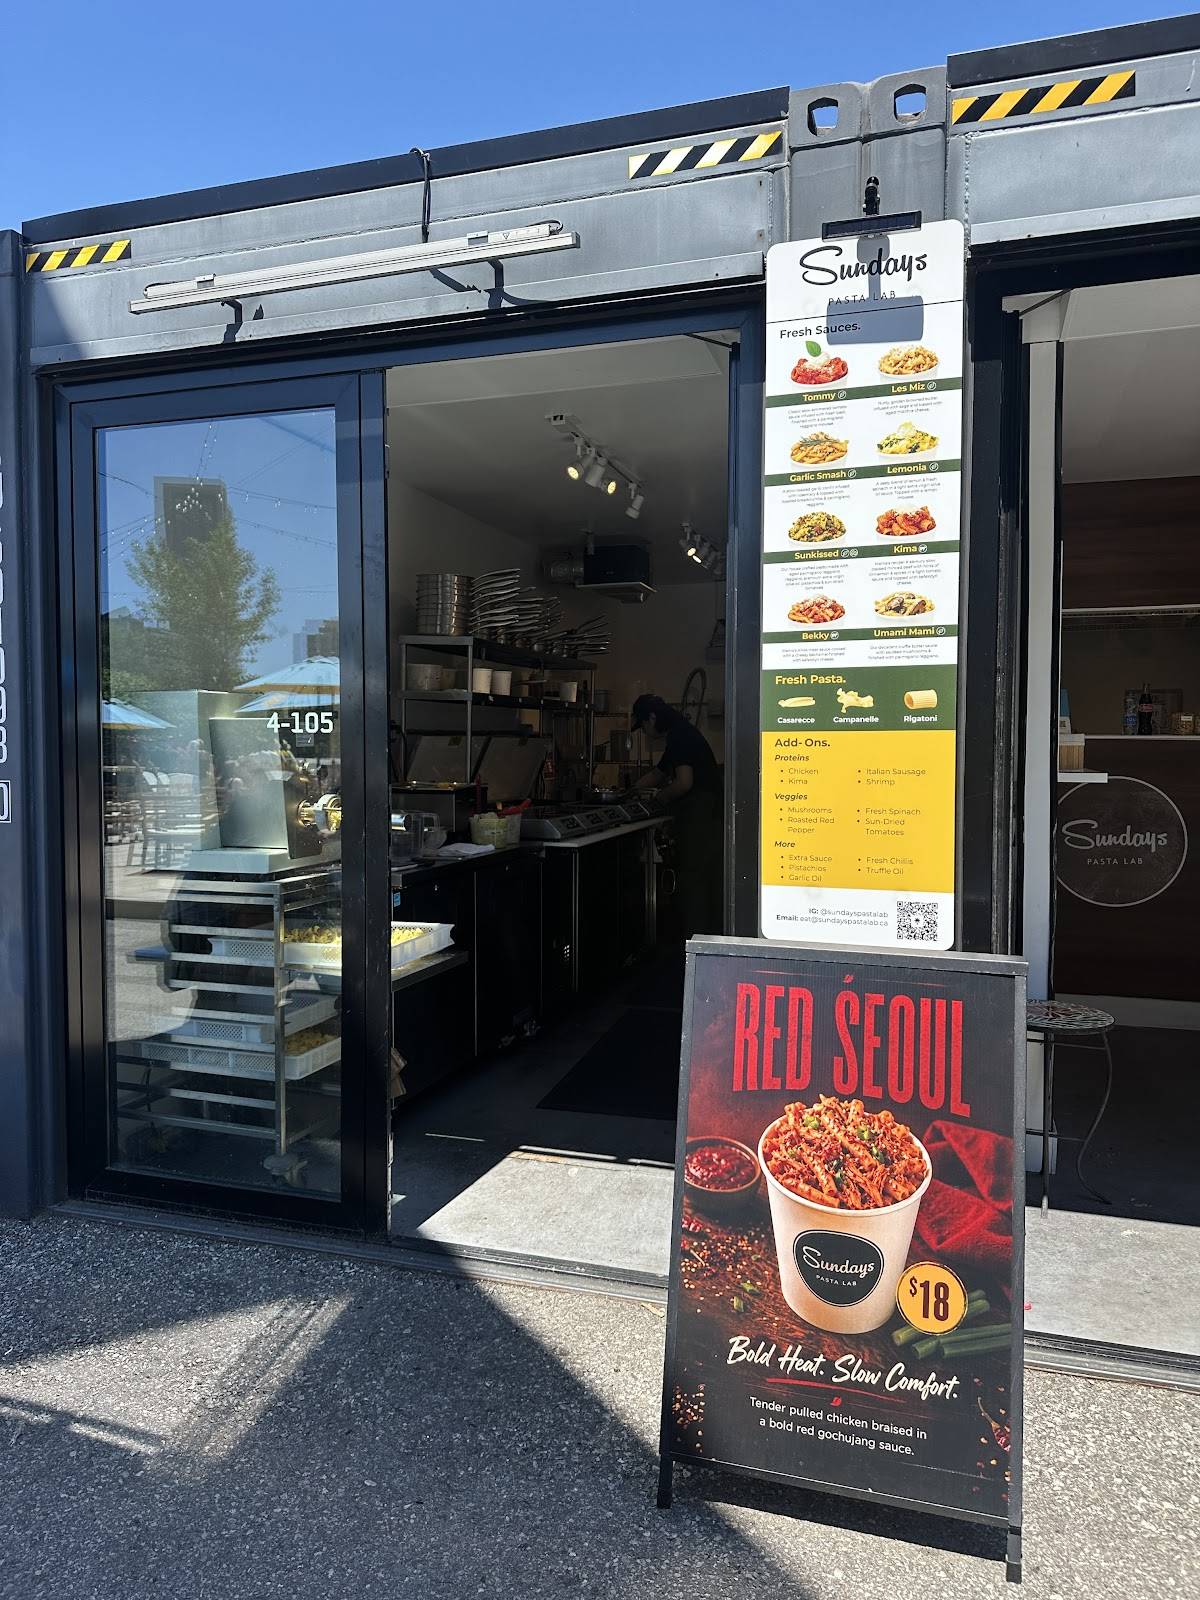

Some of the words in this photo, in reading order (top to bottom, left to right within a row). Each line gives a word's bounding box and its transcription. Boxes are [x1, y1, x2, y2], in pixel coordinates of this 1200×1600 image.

[800, 245, 928, 286] Sundays
[828, 294, 866, 306] PASTA
[873, 290, 896, 300] LAB
[780, 327, 812, 339] Fresh
[816, 322, 861, 335] Sauces.
[891, 384, 908, 393] Les
[909, 382, 926, 392] Miz
[802, 393, 836, 402] Tommy
[887, 464, 926, 474] Lemonia
[790, 473, 814, 482] Garlic
[817, 471, 847, 480] Smash
[893, 544, 917, 554] Kima
[794, 550, 839, 560] Sunkissed
[802, 632, 830, 641] Bekky
[873, 628, 906, 637] Umami
[909, 627, 934, 636] Mami
[775, 675, 807, 685] Fresh
[810, 674, 846, 684] Pasta.
[266, 712, 334, 734] 4-105
[833, 716, 879, 724] Campanelle
[904, 715, 938, 723] Rigatoni
[774, 754, 810, 762] Proteins
[892, 768, 926, 776] Sausage
[866, 778, 895, 786] Shrimp
[774, 793, 808, 801] Veggies
[889, 808, 920, 816] Spinach
[788, 816, 818, 824] Roasted
[866, 818, 905, 826] Sun-Dried
[788, 827, 815, 835] Pepper
[866, 828, 904, 836] Tomatoes
[1062, 819, 1168, 853] Sundays
[774, 840, 796, 848] More
[1123, 857, 1143, 865] LAB
[788, 874, 810, 882] Garlic
[820, 909, 888, 918] @sundayspastalab
[776, 914, 798, 922] Email:
[800, 916, 888, 926] eat@sundayspastalab.ca
[732, 982, 814, 1092] RED
[833, 990, 971, 1118] SEOUL
[802, 1246, 874, 1279] Sundays
[816, 1274, 839, 1286] PASTA
[909, 1276, 950, 1322] $18
[726, 1336, 775, 1365] Bold
[778, 1346, 824, 1376] Heat.
[832, 1354, 882, 1386] Slow
[884, 1362, 960, 1400] Comfort.
[750, 1396, 786, 1414] Tender
[789, 1404, 823, 1421] pulled
[826, 1410, 868, 1428] chicken
[871, 1419, 913, 1438] braised
[916, 1428, 927, 1440] in
[759, 1419, 766, 1427] a
[769, 1417, 793, 1432] bold
[796, 1423, 815, 1436] red
[817, 1428, 876, 1450] gochujang
[878, 1440, 915, 1456] sauce.
